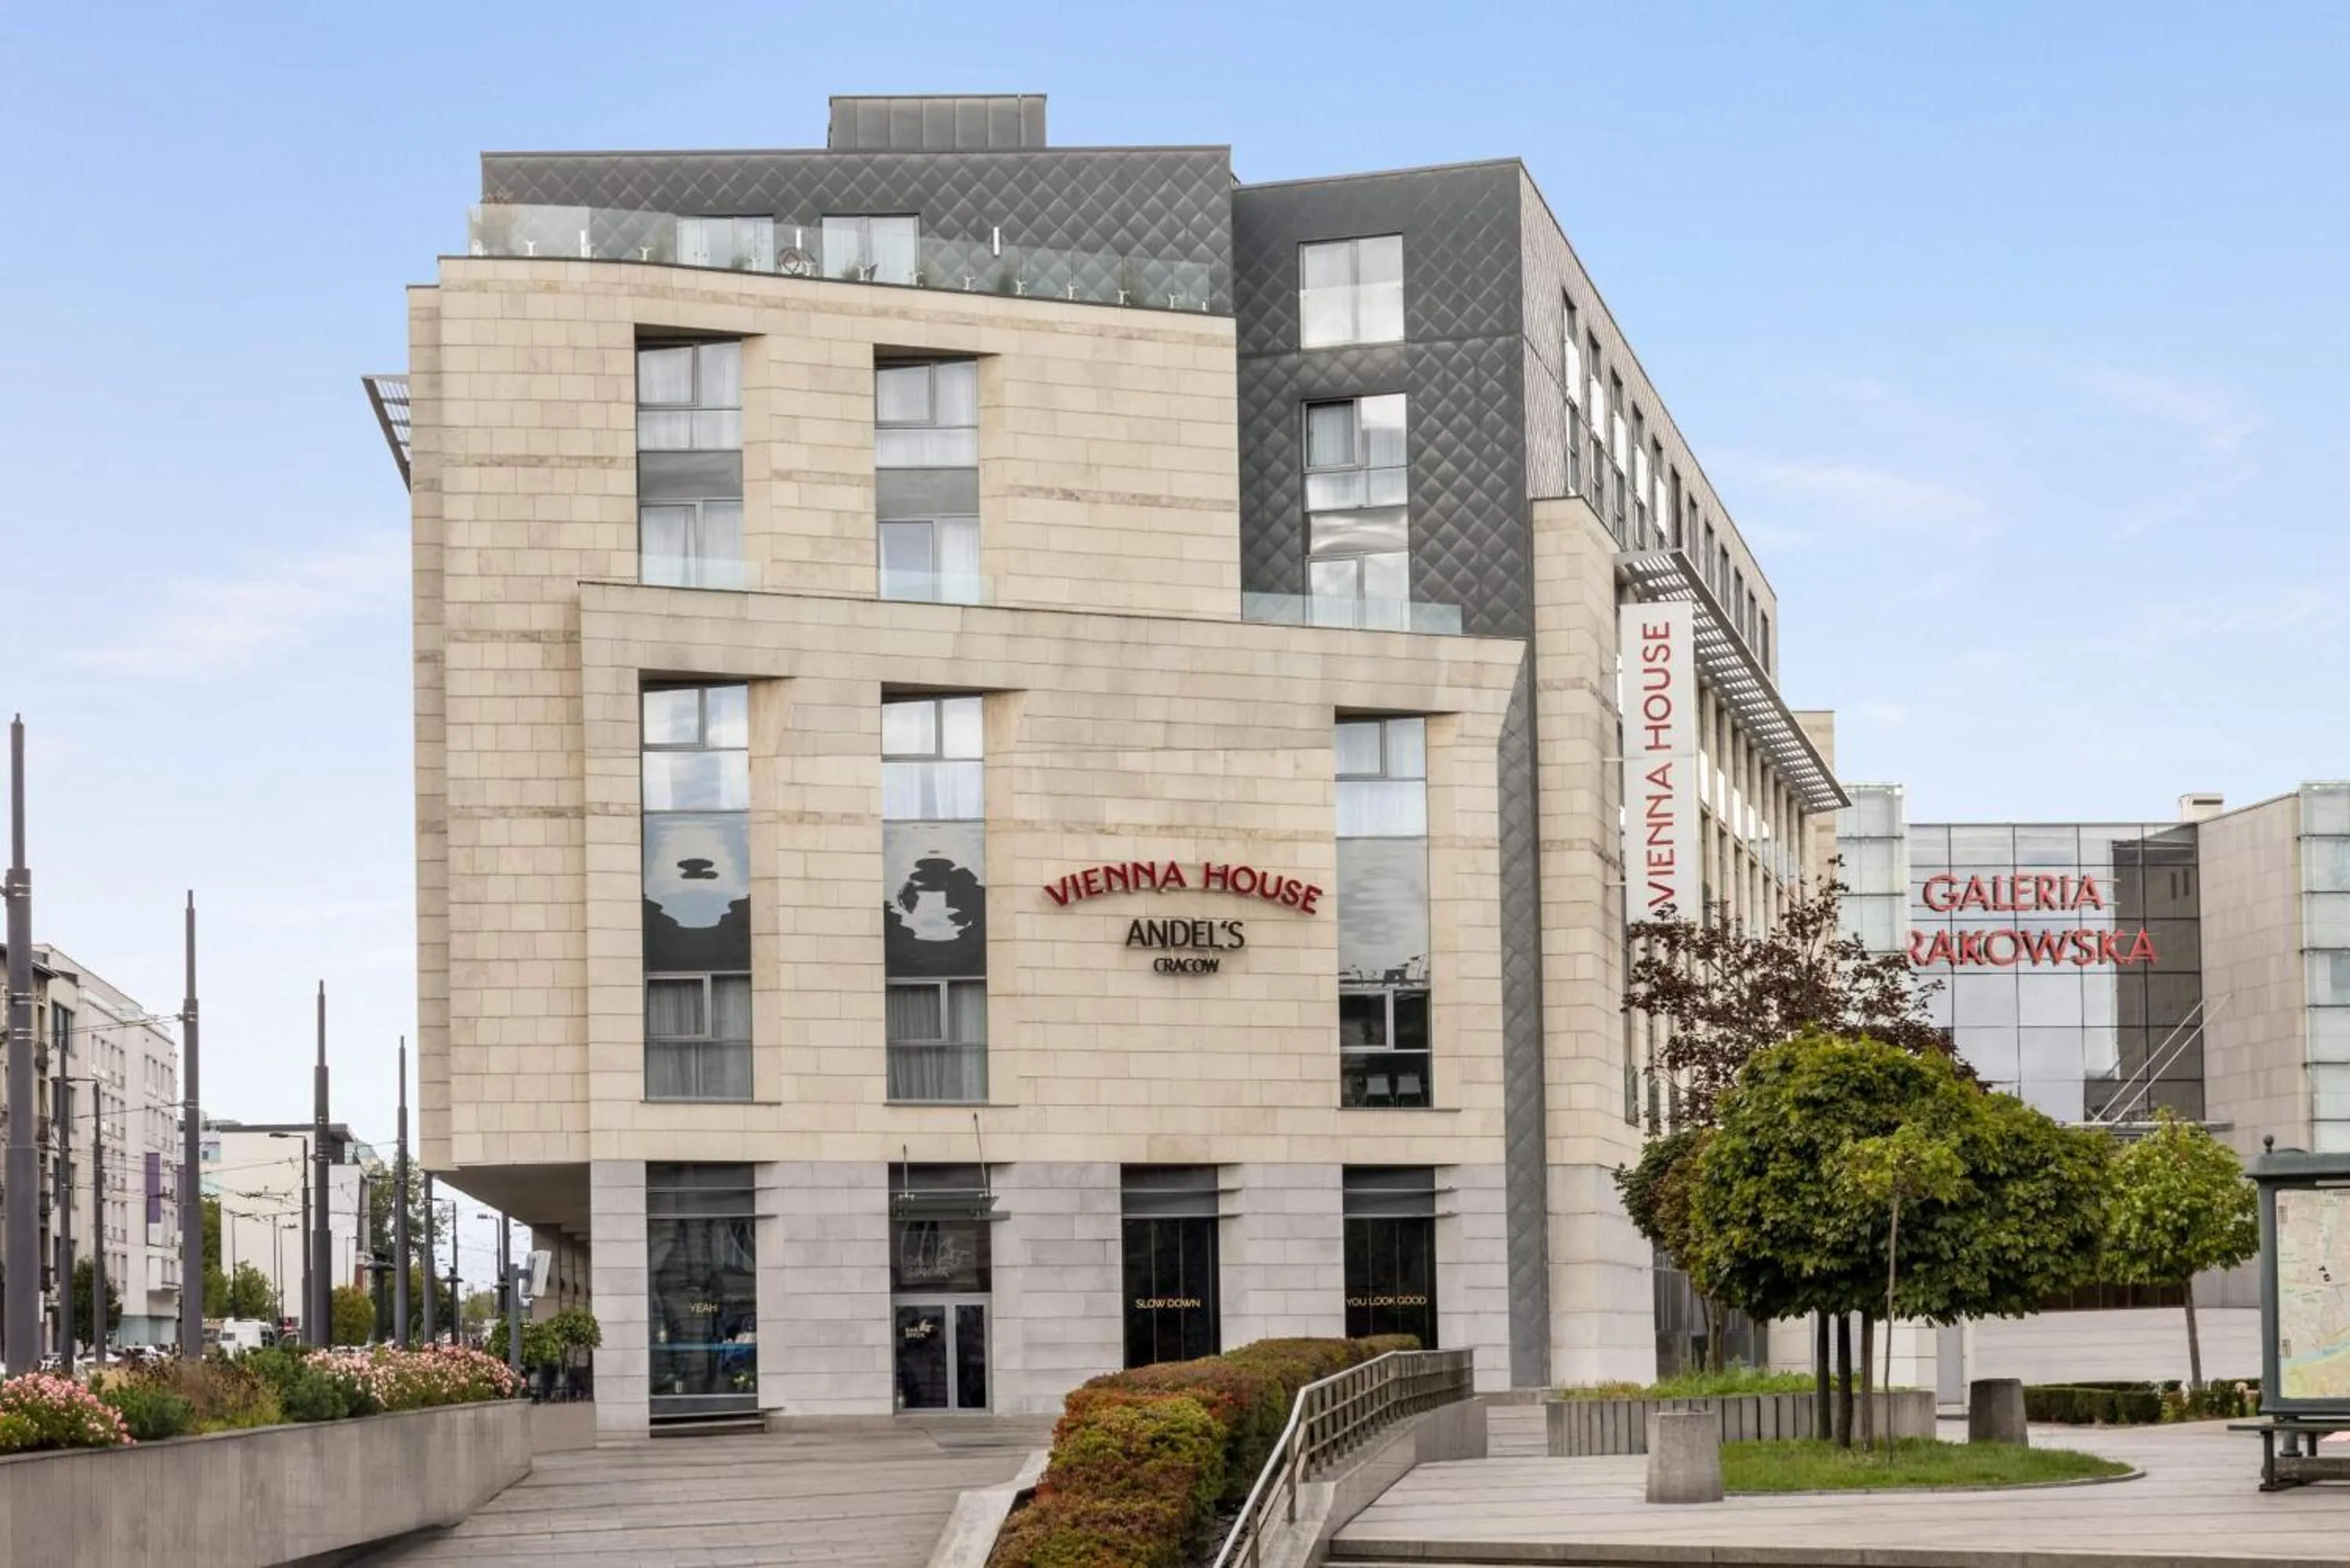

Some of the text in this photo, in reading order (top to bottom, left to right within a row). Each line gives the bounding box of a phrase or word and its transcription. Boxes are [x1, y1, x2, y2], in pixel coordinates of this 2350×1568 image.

[1642, 622, 1675, 907] VIENNA HOUSE
[1043, 861, 1323, 915] VIENNA HOUSE
[1922, 875, 2104, 912] GALERIA
[1125, 919, 1246, 949] ANDEL'S
[1153, 957, 1220, 974] CRACOW
[689, 1302, 718, 1313] YEAH
[1135, 1298, 1201, 1309] SLOW DOWN
[1347, 1295, 1426, 1307] YOU LOOK GOOD
